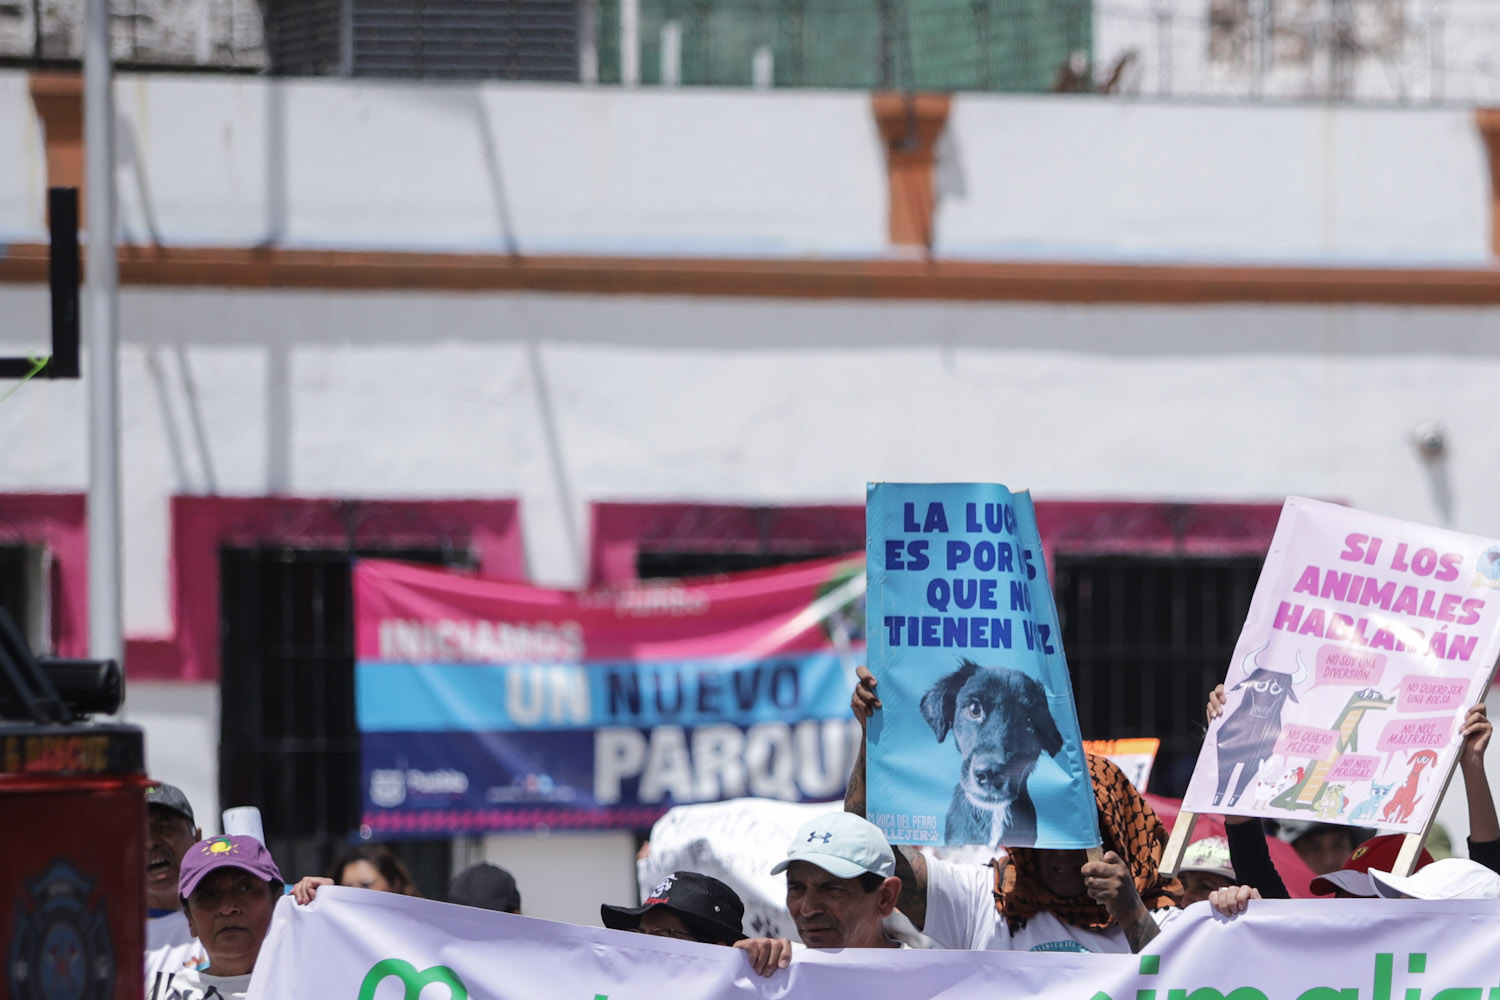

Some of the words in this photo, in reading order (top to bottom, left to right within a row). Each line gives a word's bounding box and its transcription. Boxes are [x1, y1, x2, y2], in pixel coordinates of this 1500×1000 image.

[904, 502, 949, 533] LA
[885, 540, 930, 571] ES
[946, 540, 1014, 573] POR
[1340, 532, 1383, 566] SI
[1390, 542, 1464, 582] LOS
[926, 578, 998, 612] QUE
[1010, 580, 1032, 613] NO
[1293, 564, 1486, 626] ANIMALES
[884, 616, 1012, 649] TIENEN
[1326, 655, 1340, 665] NO
[505, 664, 592, 727] UN
[604, 667, 801, 717] NUEVO
[1405, 683, 1417, 693] NO
[1418, 684, 1449, 696] QUIERO
[1286, 729, 1299, 740] NO
[1300, 732, 1333, 746] QUIERO
[1402, 723, 1416, 734] NO
[1417, 723, 1437, 735] NOS
[1341, 757, 1353, 767] NO
